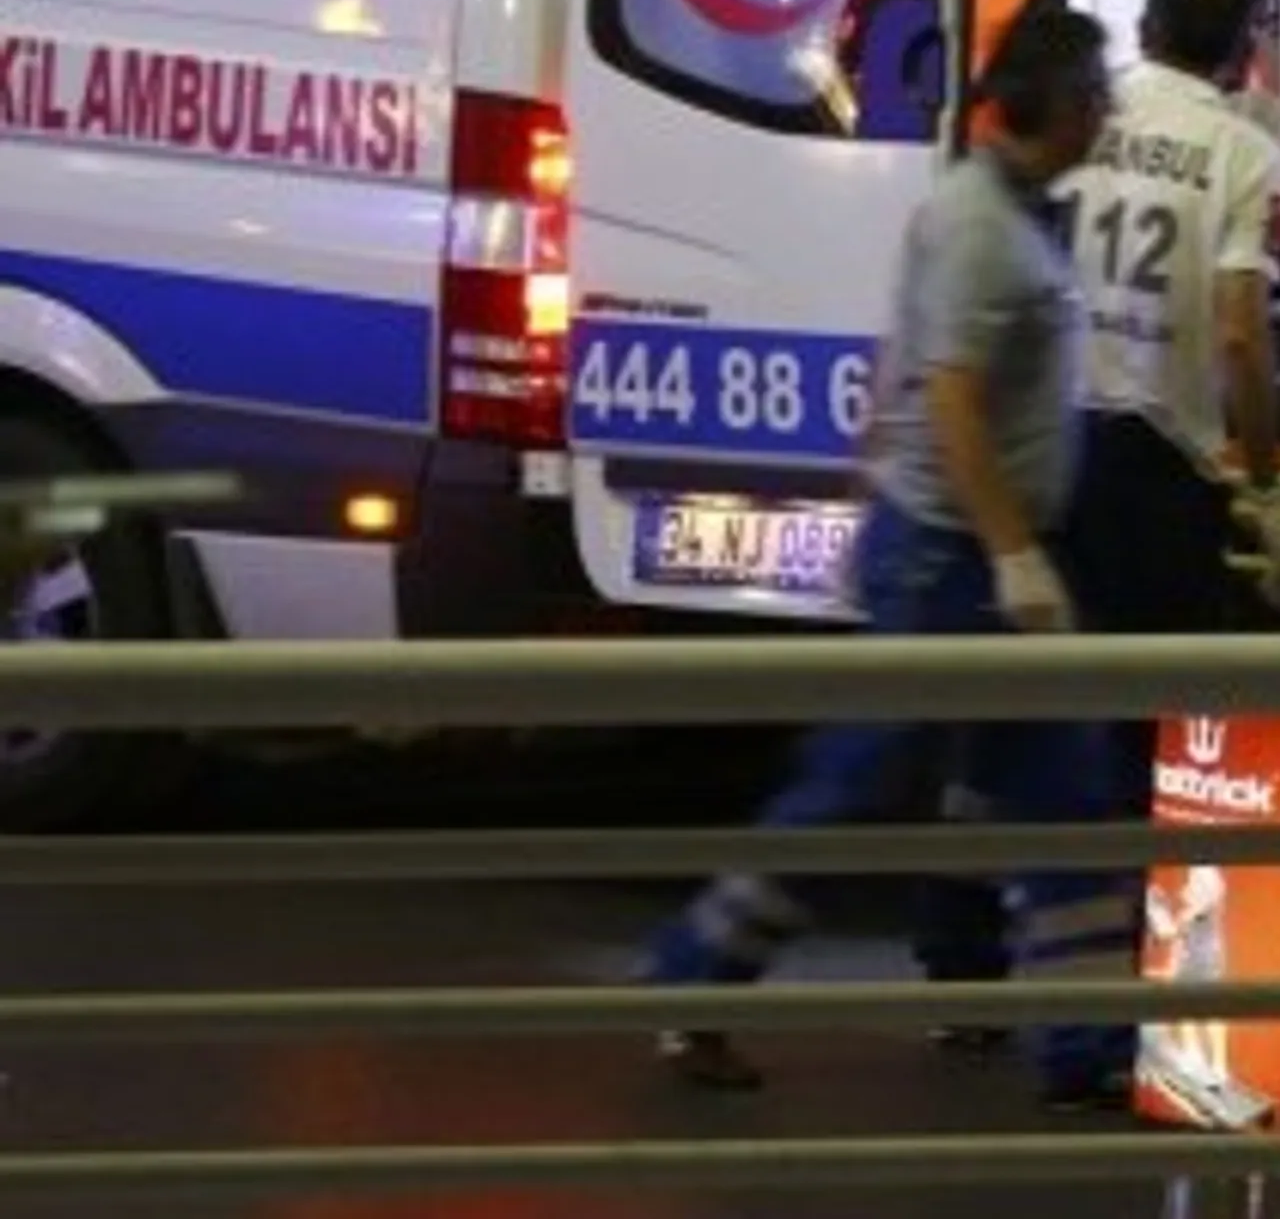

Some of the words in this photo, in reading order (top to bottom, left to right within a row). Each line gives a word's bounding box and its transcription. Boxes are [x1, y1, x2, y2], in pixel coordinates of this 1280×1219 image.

[576, 339, 696, 426] 444
[717, 347, 804, 433] 88
[661, 510, 706, 567] 34
